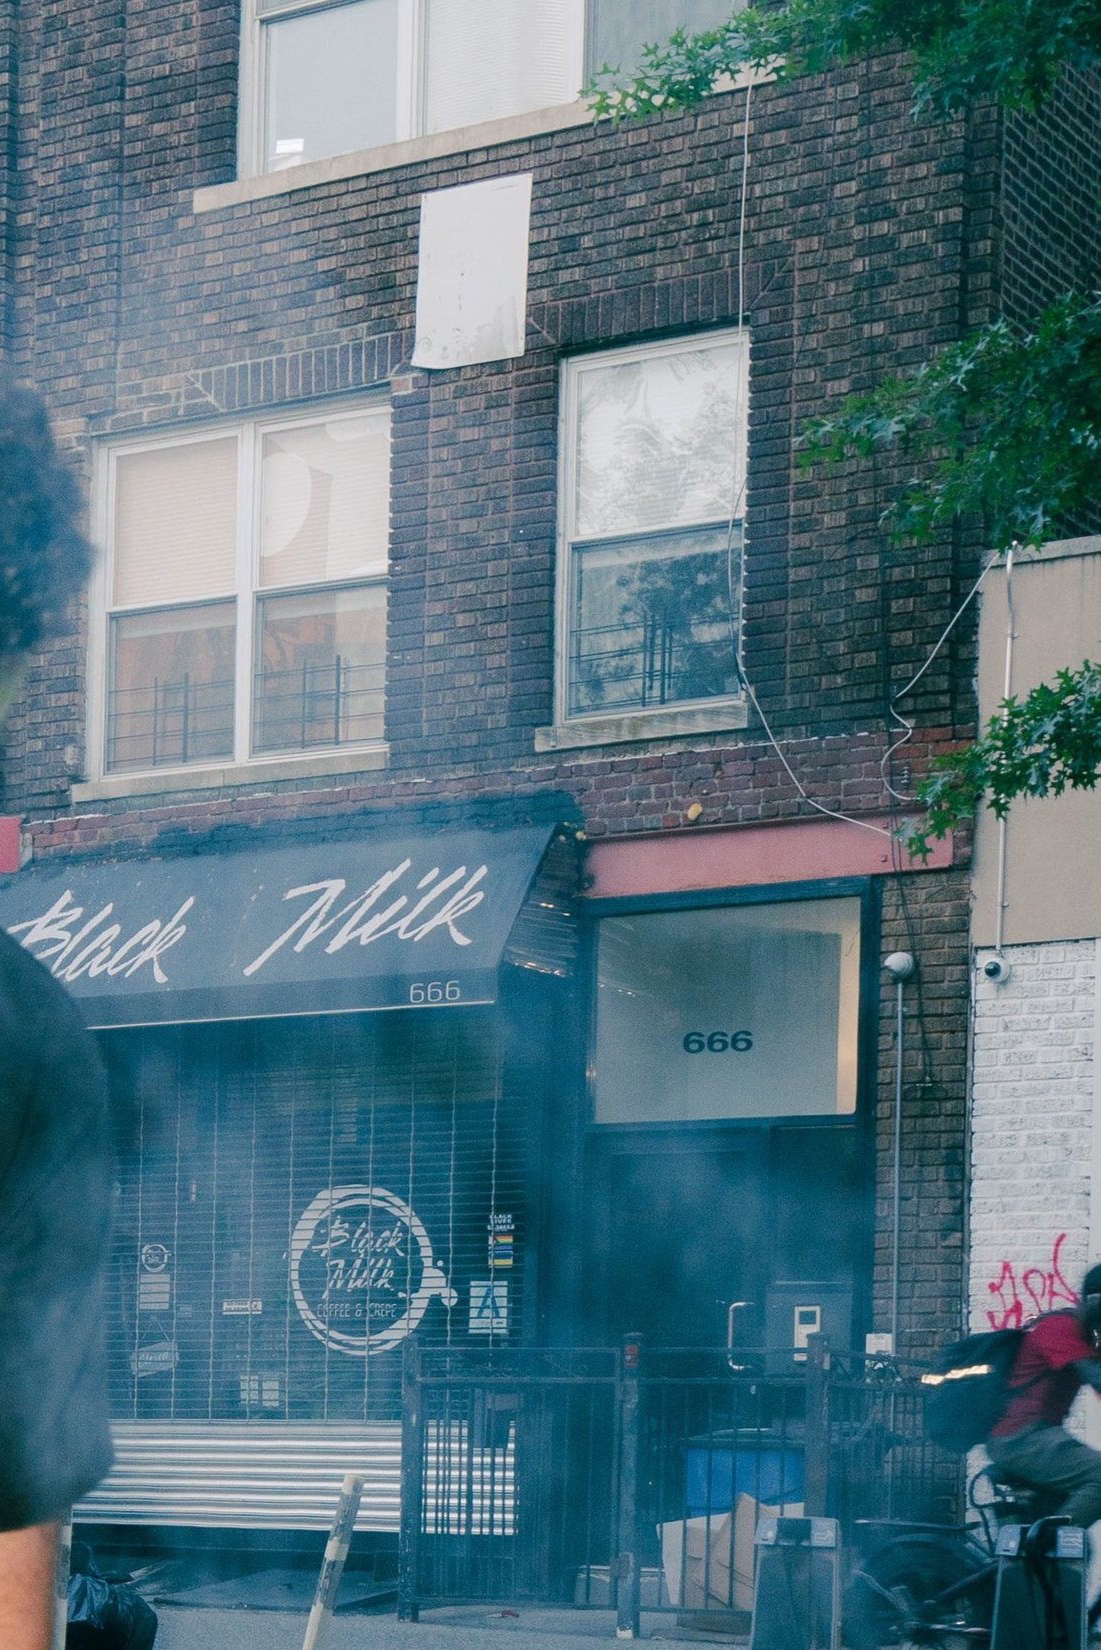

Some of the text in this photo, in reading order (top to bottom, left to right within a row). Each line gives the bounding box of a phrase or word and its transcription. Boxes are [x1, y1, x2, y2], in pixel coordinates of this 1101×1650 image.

[7, 858, 488, 984] Black Milk
[410, 980, 460, 1003] 666
[683, 1030, 753, 1053] 666
[311, 1215, 404, 1258] Black
[321, 1255, 394, 1299] Milk
[316, 1303, 351, 1318] COFFEE
[477, 1284, 501, 1318] A
